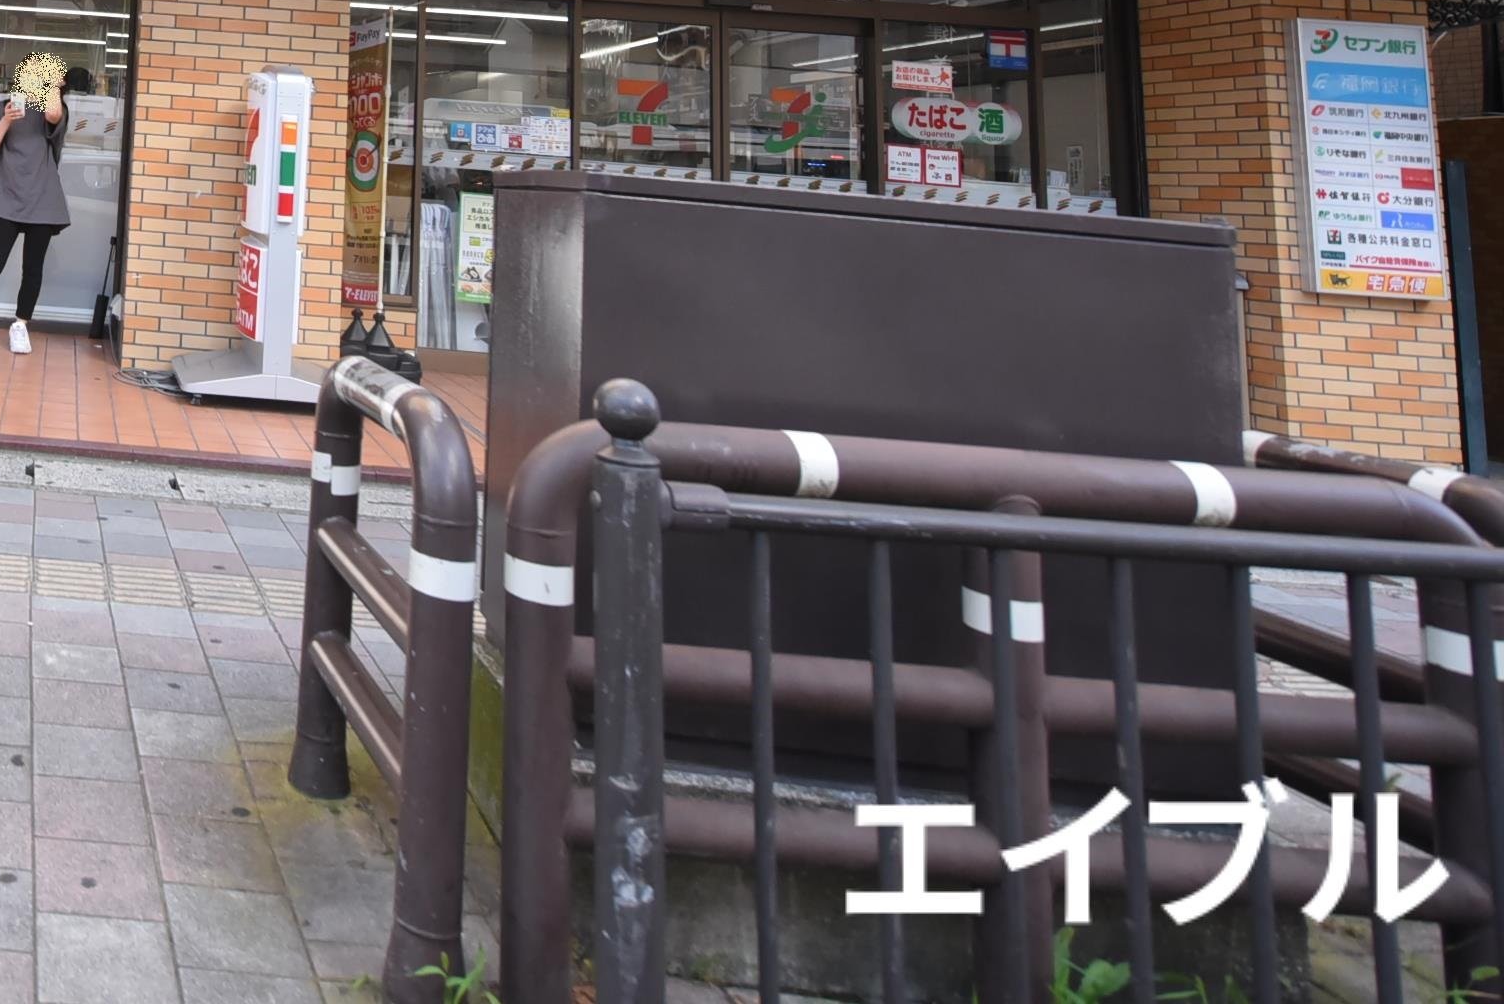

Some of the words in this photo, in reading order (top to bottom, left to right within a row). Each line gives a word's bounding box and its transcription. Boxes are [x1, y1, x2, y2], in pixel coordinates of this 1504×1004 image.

[1344, 35, 1416, 55] セブン銀行
[908, 102, 967, 131] たばこ
[978, 107, 1004, 134] 酒
[1383, 110, 1427, 121] 北九州銀行
[919, 129, 955, 140] cigarette
[981, 134, 1005, 143] liquor
[897, 150, 912, 158] ATM
[1326, 148, 1367, 159] りそな銀行
[1392, 196, 1434, 208] 大分銀行
[1347, 232, 1433, 249] 各種公共料金窓口
[1367, 274, 1426, 294] 宅急便
